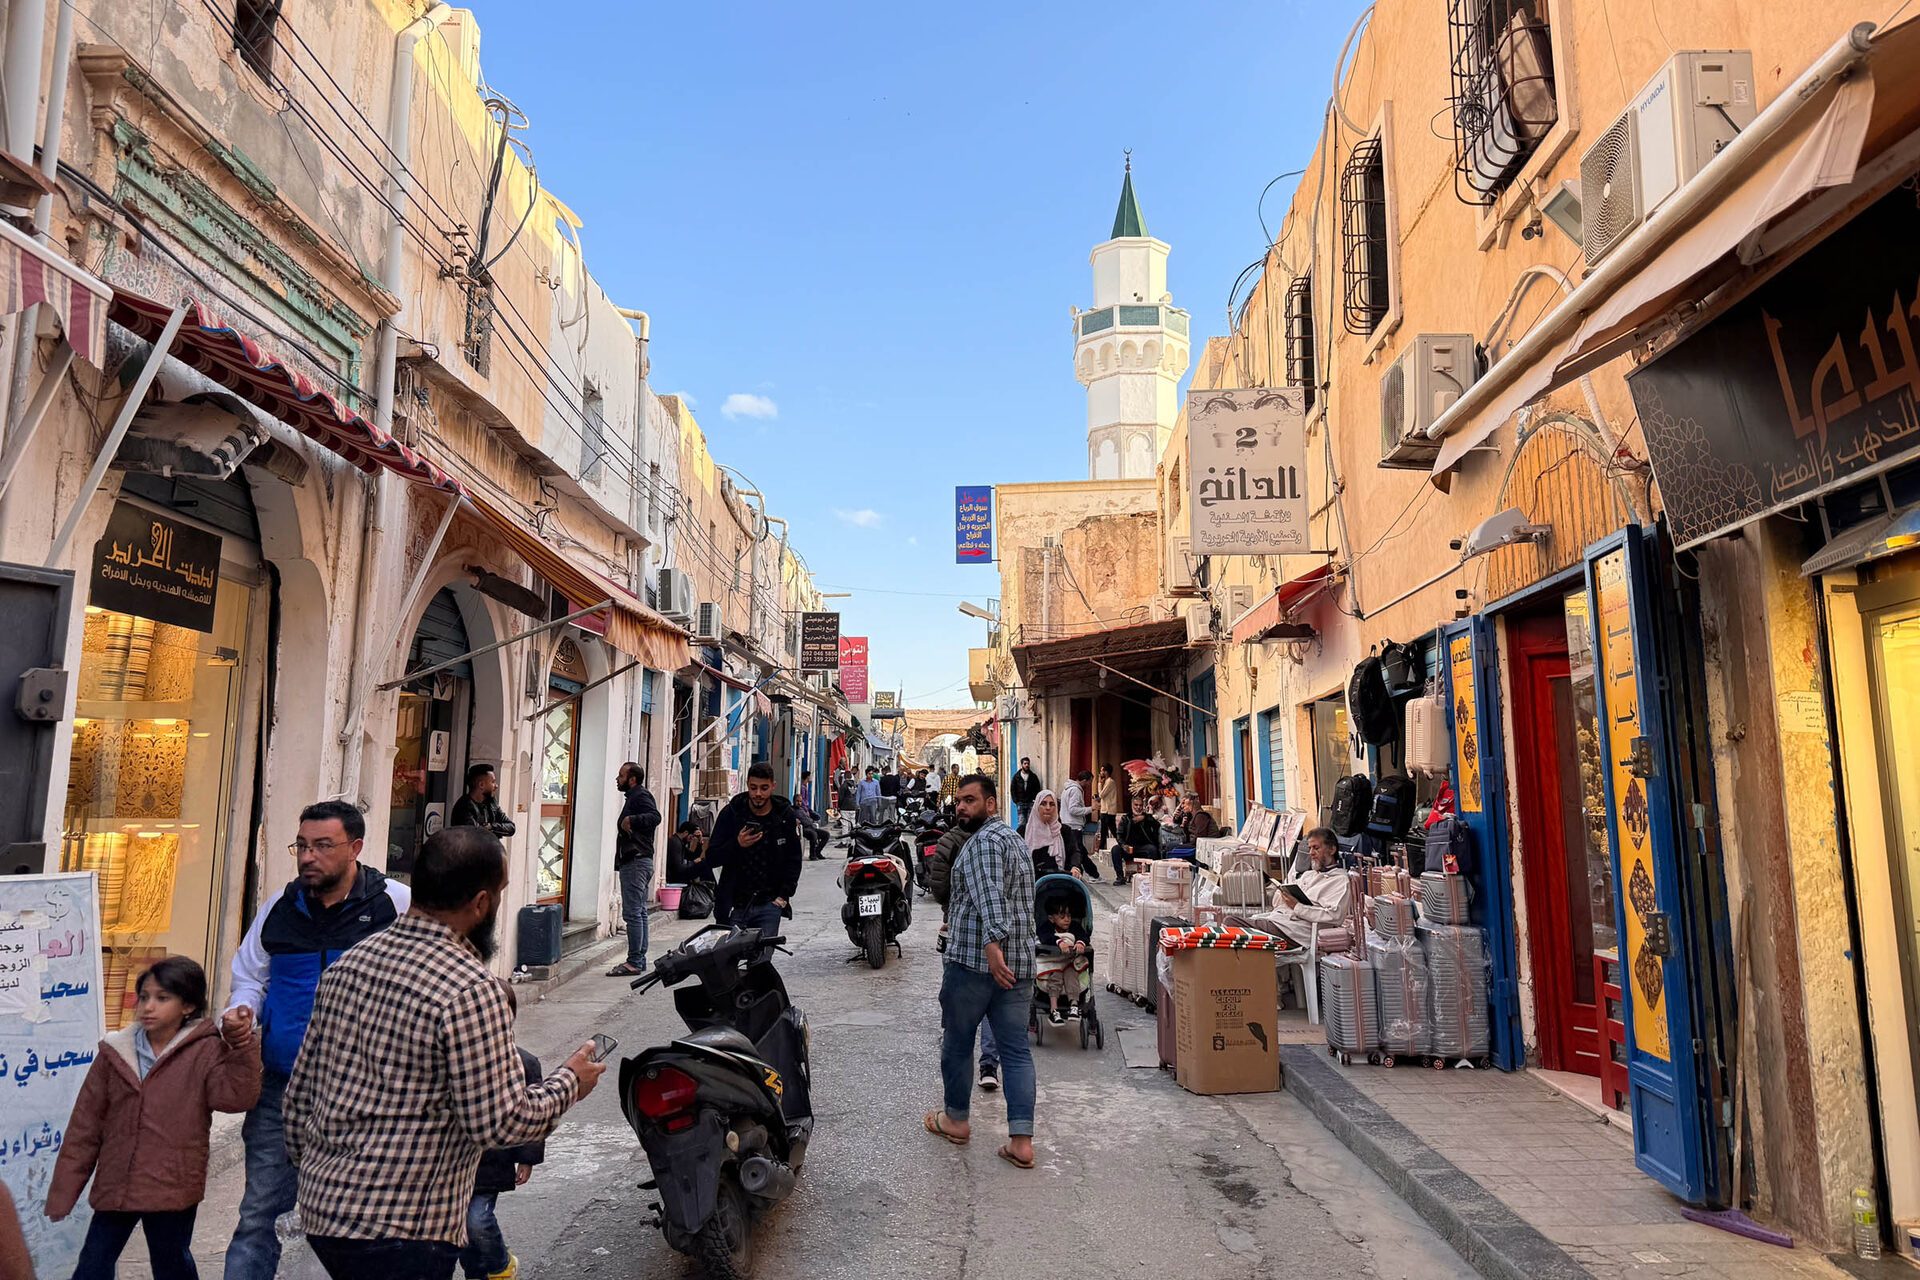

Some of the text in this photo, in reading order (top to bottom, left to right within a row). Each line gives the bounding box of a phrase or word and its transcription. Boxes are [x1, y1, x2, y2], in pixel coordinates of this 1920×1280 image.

[1640, 80, 1666, 113] HYUNDAI
[1235, 427, 1259, 449] 2
[1763, 390, 1920, 504] للذهب والفضة
[129, 572, 152, 590] وبدل
[860, 904, 877, 914] 6421
[14, 1047, 39, 1088] في
[44, 1048, 94, 1077] سحب
